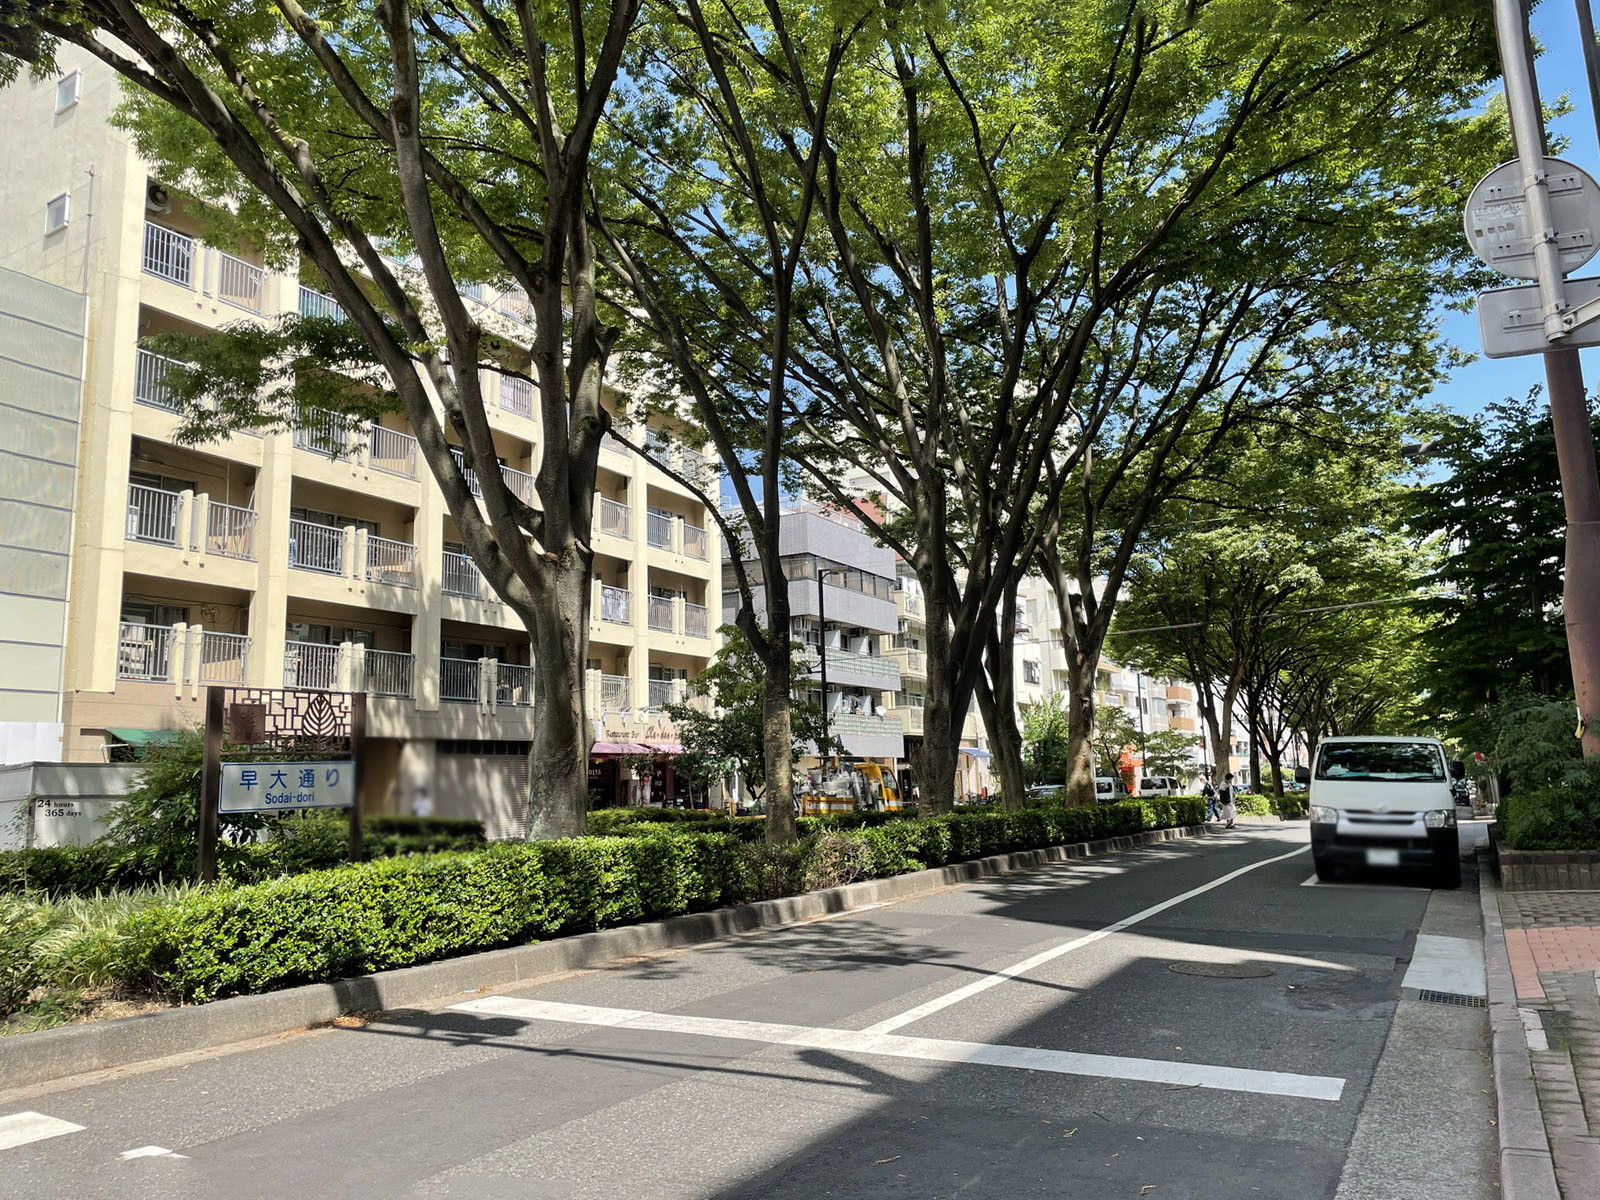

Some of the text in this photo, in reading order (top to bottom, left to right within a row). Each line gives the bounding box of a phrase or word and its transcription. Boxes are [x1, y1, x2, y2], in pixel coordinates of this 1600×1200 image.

[240, 768, 340, 791] 早大通り
[37, 799, 51, 808] 24
[265, 792, 315, 805] Sodai-dori
[45, 808, 82, 818] 365 days
